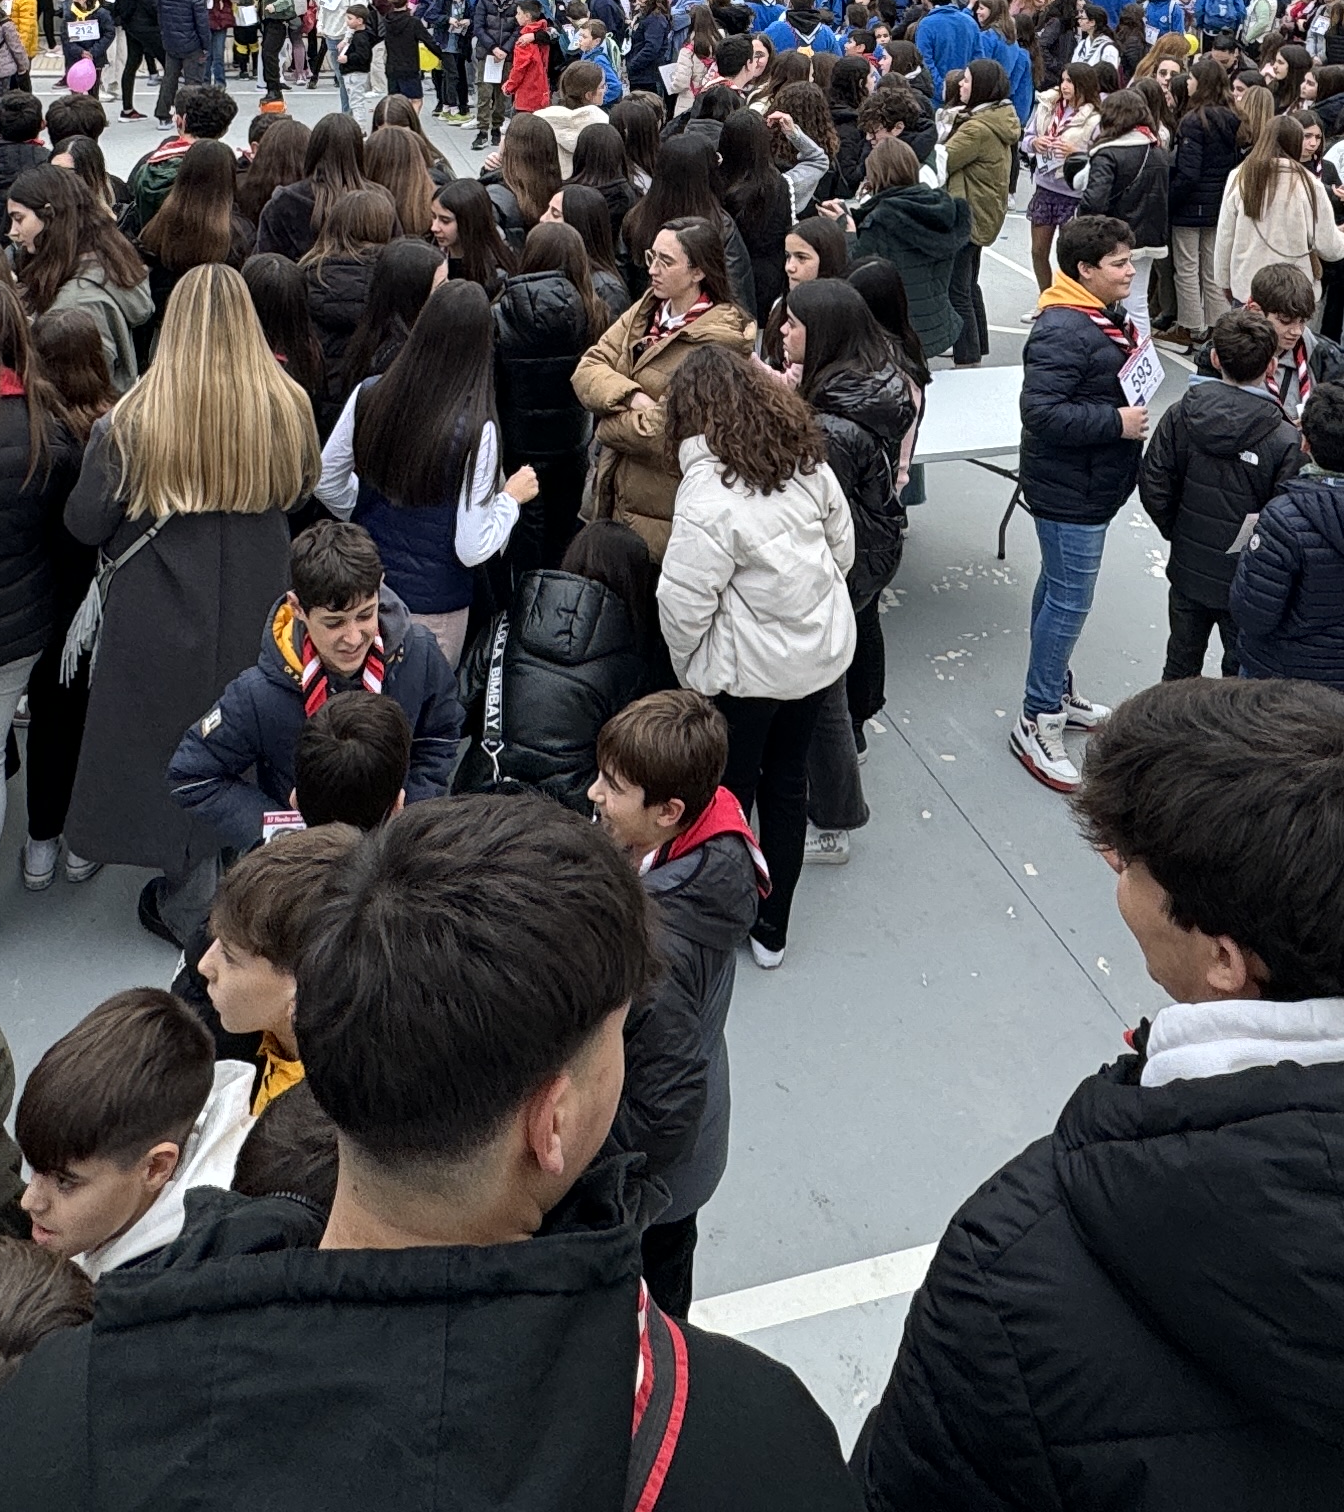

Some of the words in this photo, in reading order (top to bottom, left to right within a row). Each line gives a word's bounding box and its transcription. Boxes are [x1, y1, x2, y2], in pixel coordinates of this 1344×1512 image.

[75, 25, 94, 36] 212
[1131, 356, 1153, 394] 593
[487, 666, 502, 729] BIMBAY
